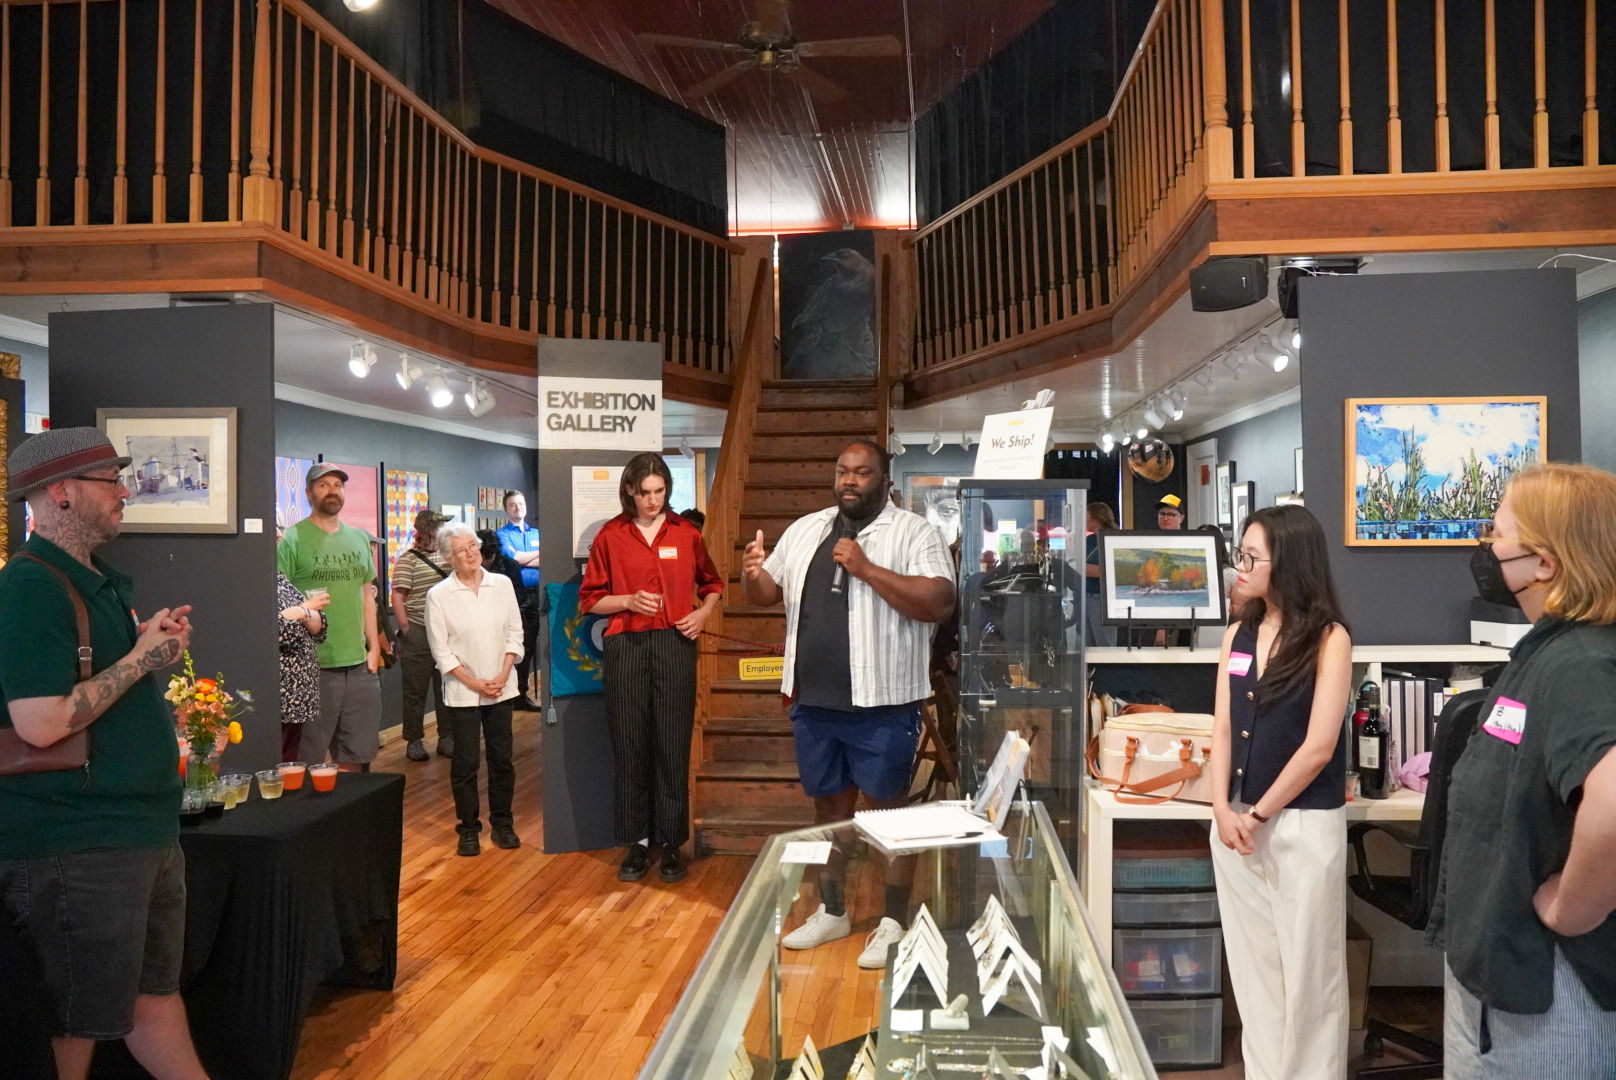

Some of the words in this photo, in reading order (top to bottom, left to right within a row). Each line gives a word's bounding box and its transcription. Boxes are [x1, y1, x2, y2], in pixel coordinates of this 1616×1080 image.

[546, 391, 656, 411] EXHIBITION
[546, 413, 637, 433] GALLERY
[992, 438, 1006, 449] We
[1008, 433, 1035, 449] Ship!
[312, 569, 350, 581] RHUBARB
